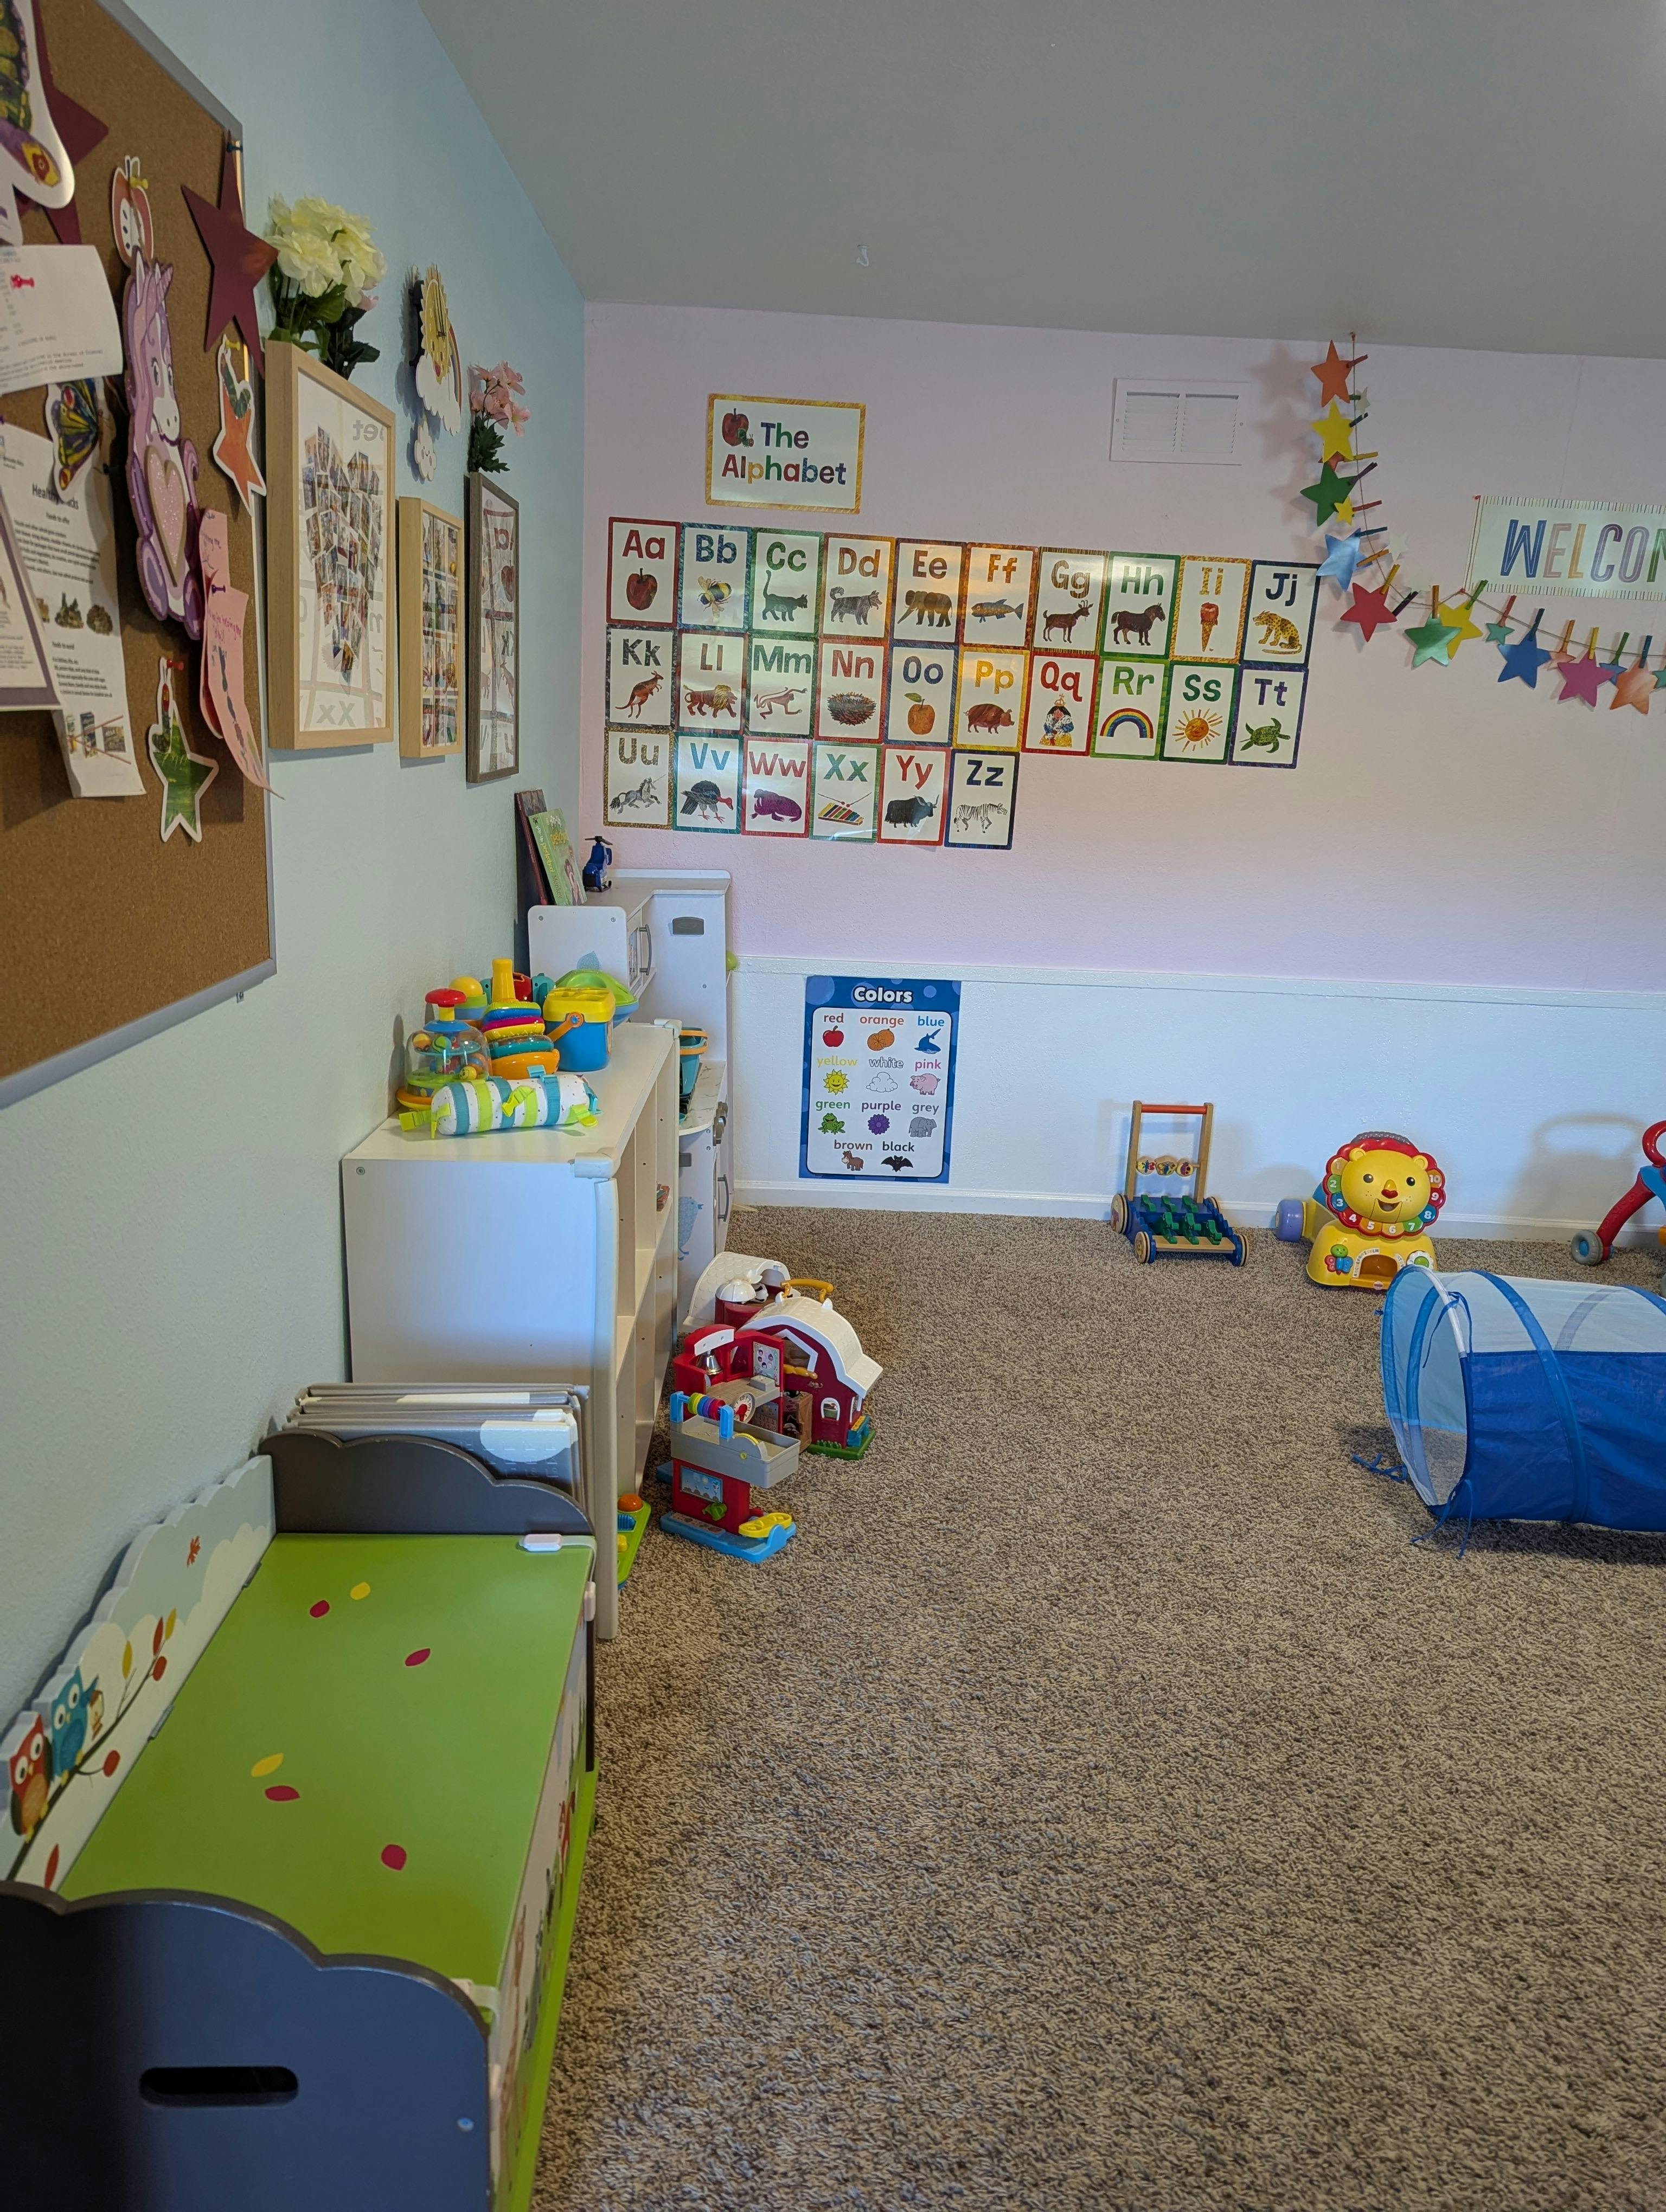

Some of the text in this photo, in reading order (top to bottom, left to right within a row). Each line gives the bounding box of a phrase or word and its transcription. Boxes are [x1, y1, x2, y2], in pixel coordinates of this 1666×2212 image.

[761, 422, 809, 449] The
[721, 454, 846, 485] Alphabet
[622, 529, 665, 560] Aa
[695, 535, 736, 564] Bb
[766, 541, 806, 571] Cc
[837, 547, 881, 578] Dd
[913, 550, 947, 579] Ee
[987, 554, 1017, 584] Ff
[1051, 560, 1090, 599] Gg
[1120, 565, 1163, 596] Hh
[1199, 567, 1223, 595] Ii
[1266, 573, 1298, 607] Jj
[622, 639, 661, 667] Kk
[700, 644, 722, 671] Ll
[753, 645, 811, 674] Mm
[832, 650, 874, 679] Nn
[903, 655, 943, 684] Oo
[975, 660, 1014, 695] Pp
[1041, 661, 1082, 702] Qq
[1113, 666, 1154, 695] Rr
[1183, 673, 1221, 702] Ss
[1254, 678, 1287, 707] Tt
[619, 737, 659, 766] Uu
[690, 743, 730, 771] Vv
[749, 751, 806, 779] Ww
[824, 754, 868, 781] Xx
[896, 755, 933, 788] Yy
[966, 760, 1003, 787] Zz
[853, 986, 913, 1004] Colors
[824, 1013, 945, 1026] red orange blue
[817, 1056, 941, 1071] yellow white pink
[816, 1100, 939, 1115] green purple grey
[834, 1140, 915, 1152] brown black
[1330, 1180, 1336, 1188] 2
[1430, 1175, 1441, 1183] 10
[1431, 1192, 1439, 1200] 9
[1349, 1214, 1356, 1222] 4
[1367, 1221, 1375, 1230] 5
[1408, 1223, 1415, 1231] 7
[1424, 1211, 1432, 1219] 8
